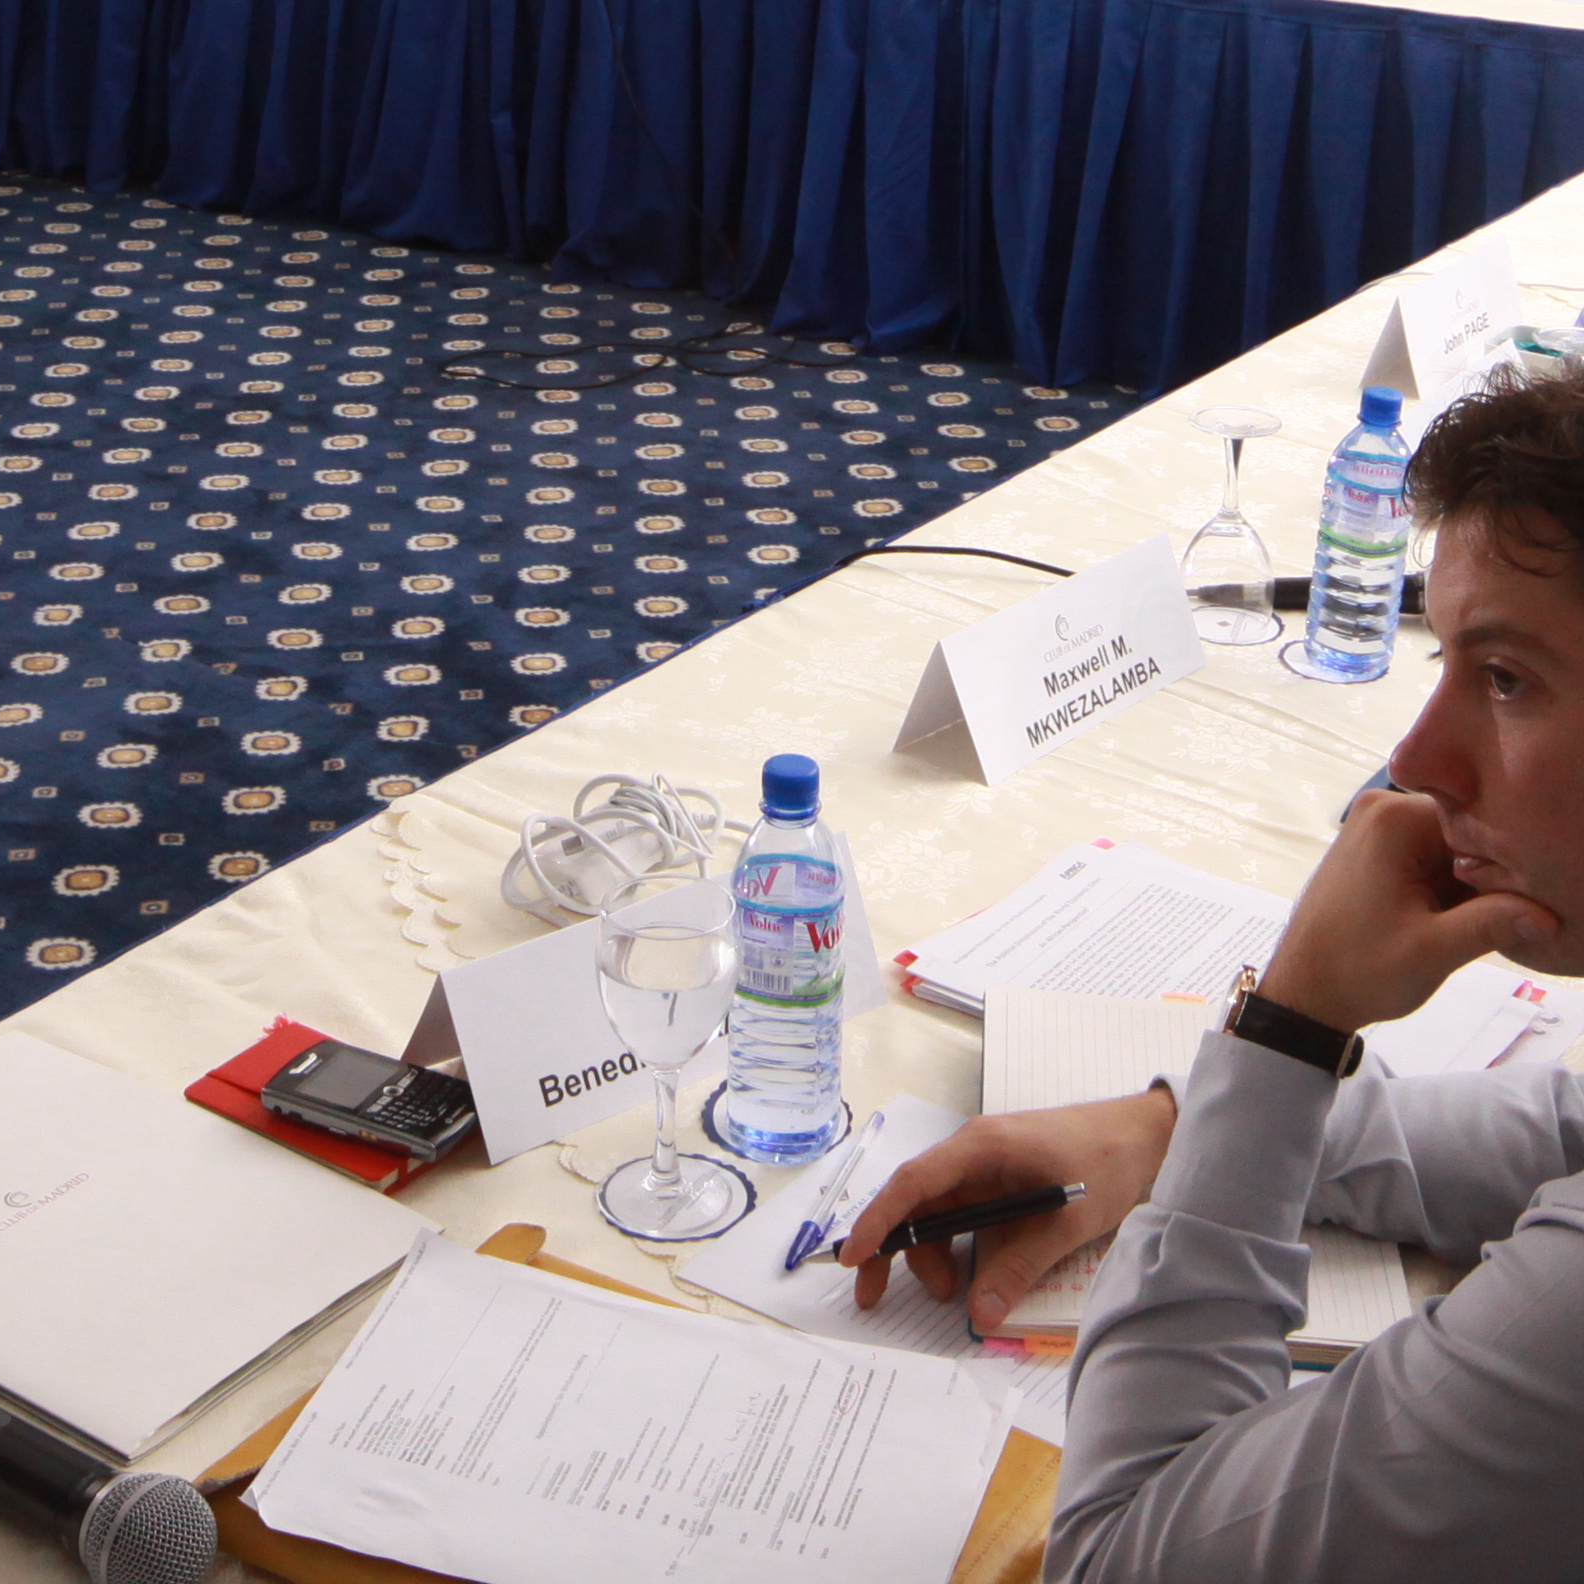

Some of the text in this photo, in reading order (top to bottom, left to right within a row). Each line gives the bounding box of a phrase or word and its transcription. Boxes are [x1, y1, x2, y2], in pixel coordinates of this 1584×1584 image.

[1444, 332, 1464, 355] John
[1464, 311, 1490, 341] PAGE
[1043, 635, 1133, 698] Maxwell M.
[1025, 656, 1162, 749] MKWEZALAMBA
[538, 1048, 647, 1108] Bened
[38, 1172, 90, 1207] MADRID
